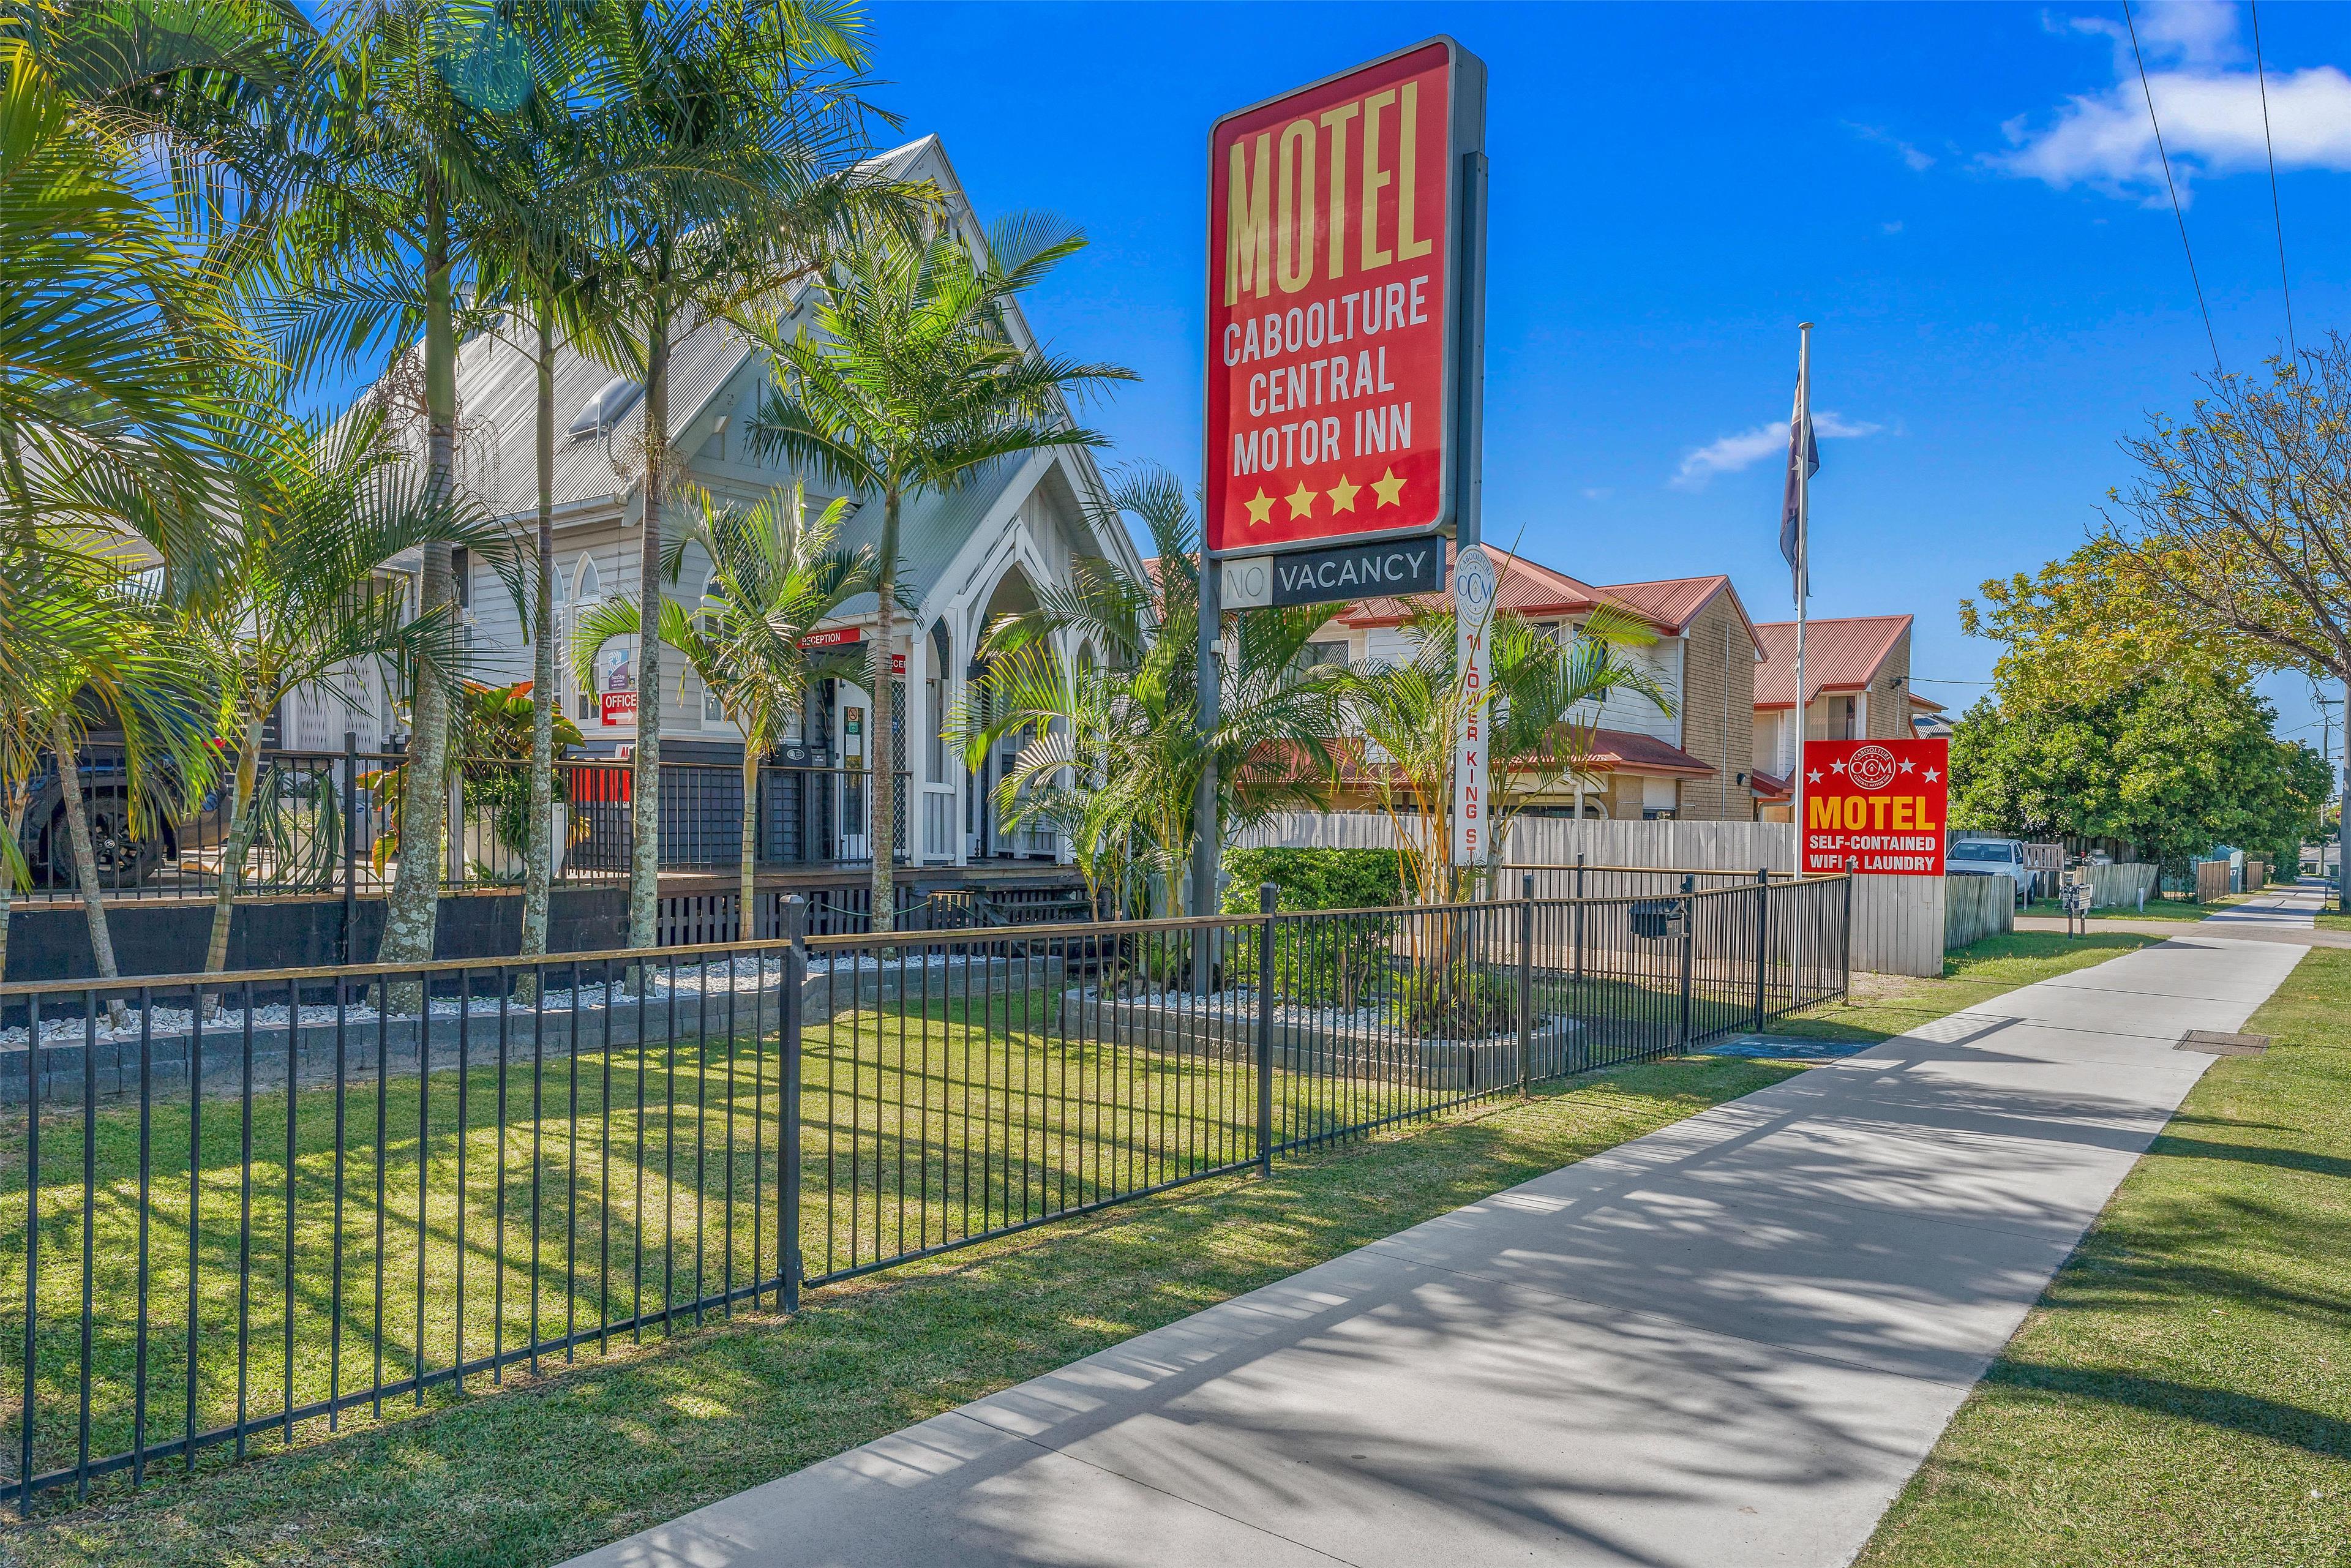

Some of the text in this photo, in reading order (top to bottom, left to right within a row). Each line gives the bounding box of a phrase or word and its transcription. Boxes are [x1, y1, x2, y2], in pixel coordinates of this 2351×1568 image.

[1224, 81, 1431, 307] MOTEL
[1224, 275, 1428, 366] CABOOLTURE
[1250, 346, 1394, 417] CENTRAL
[1234, 402, 1411, 476] MOTOR INN
[1226, 551, 1426, 599] NO VACANCY
[1460, 552, 1491, 578] CABOOLTURE
[1458, 572, 1491, 604] CCM
[802, 632, 841, 646] RECEPTION
[606, 694, 637, 708] OFFICE
[1466, 634, 1480, 865] 11 LOWER KING ST
[1854, 748, 1891, 761] CABOOLTURE
[1851, 759, 1892, 777] CCM
[1853, 775, 1869, 787] CENTRAL
[1810, 796, 1935, 830] MOTEL
[1809, 835, 1935, 851] SELF-CONTAINED
[1810, 854, 1935, 871] WIFI & LAUNDRY
